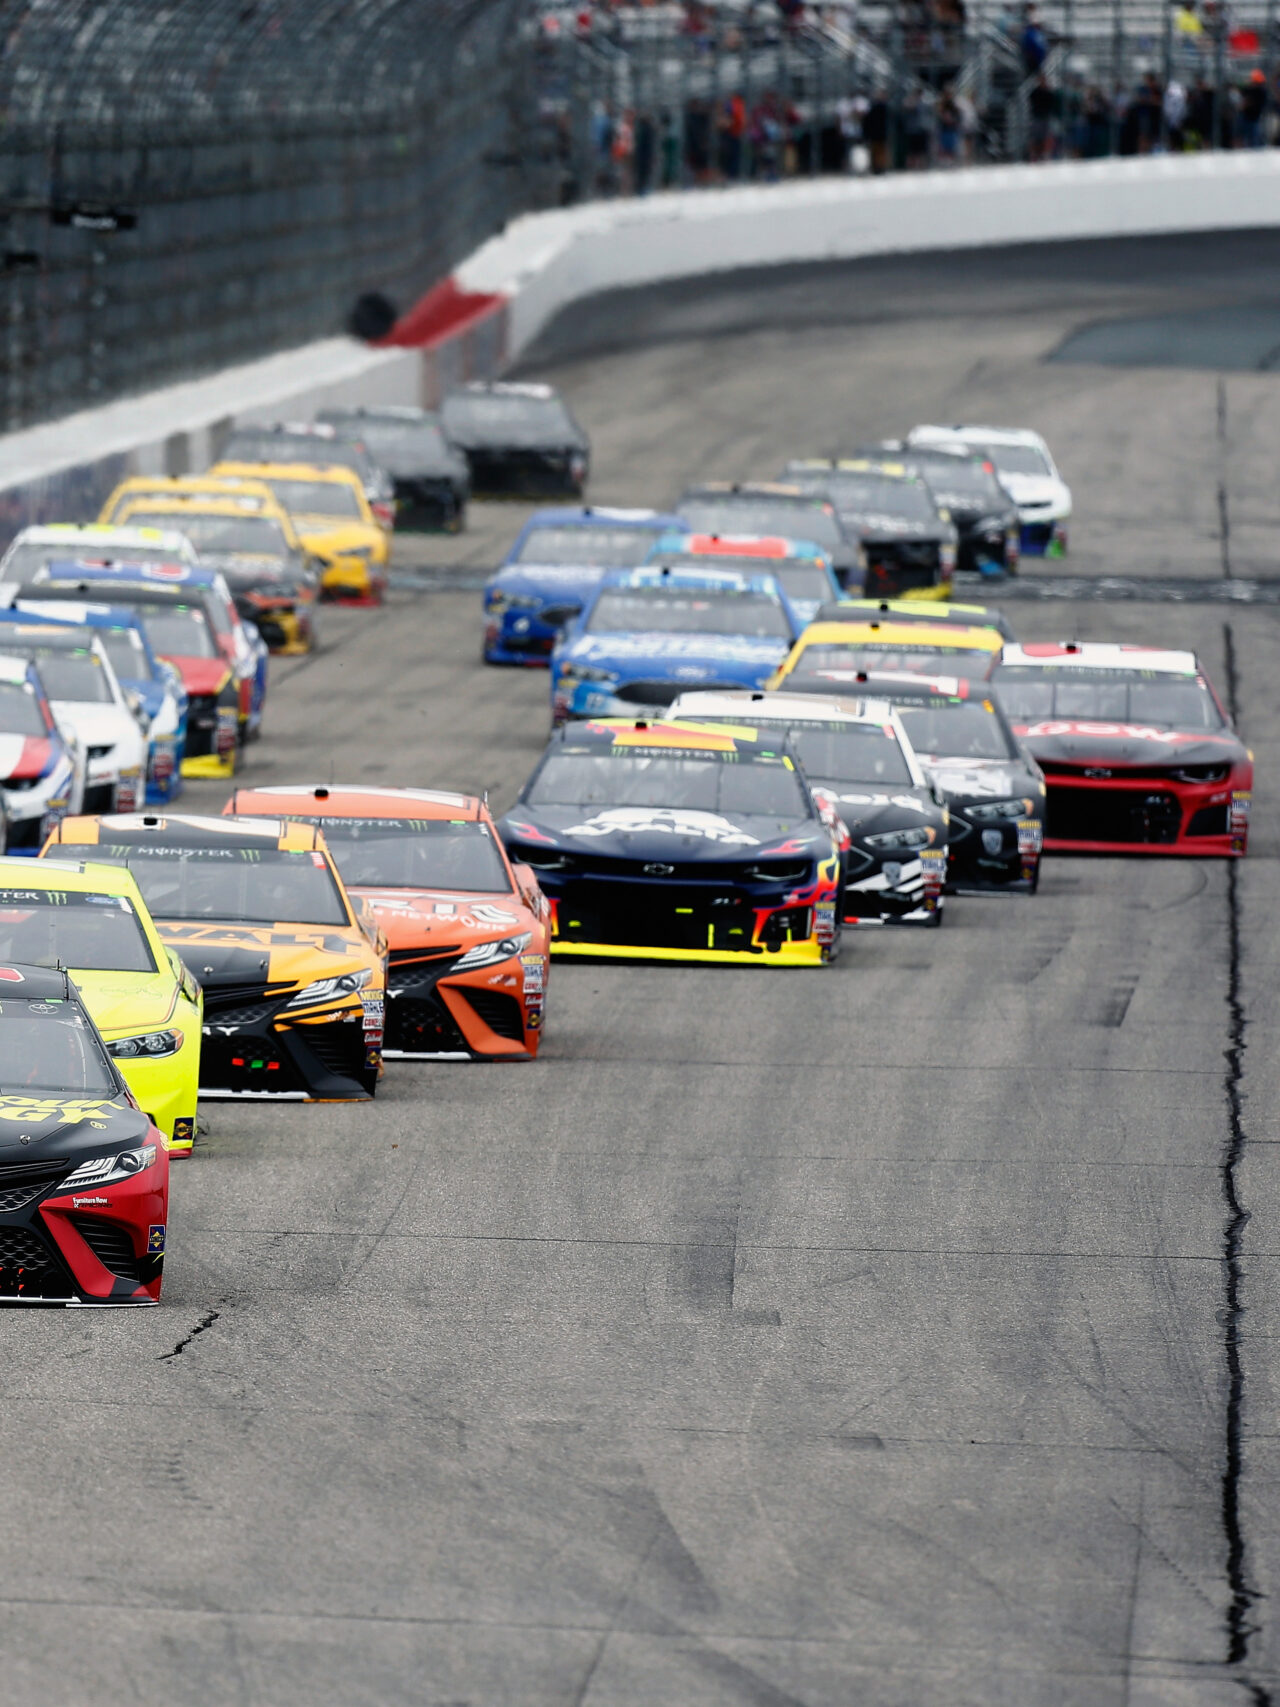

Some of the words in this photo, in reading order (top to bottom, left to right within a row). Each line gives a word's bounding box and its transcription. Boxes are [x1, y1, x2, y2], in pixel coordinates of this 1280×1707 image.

[138, 846, 234, 858] MONSTER
[392, 909, 508, 932] NETWORK
[154, 925, 361, 955] WALT
